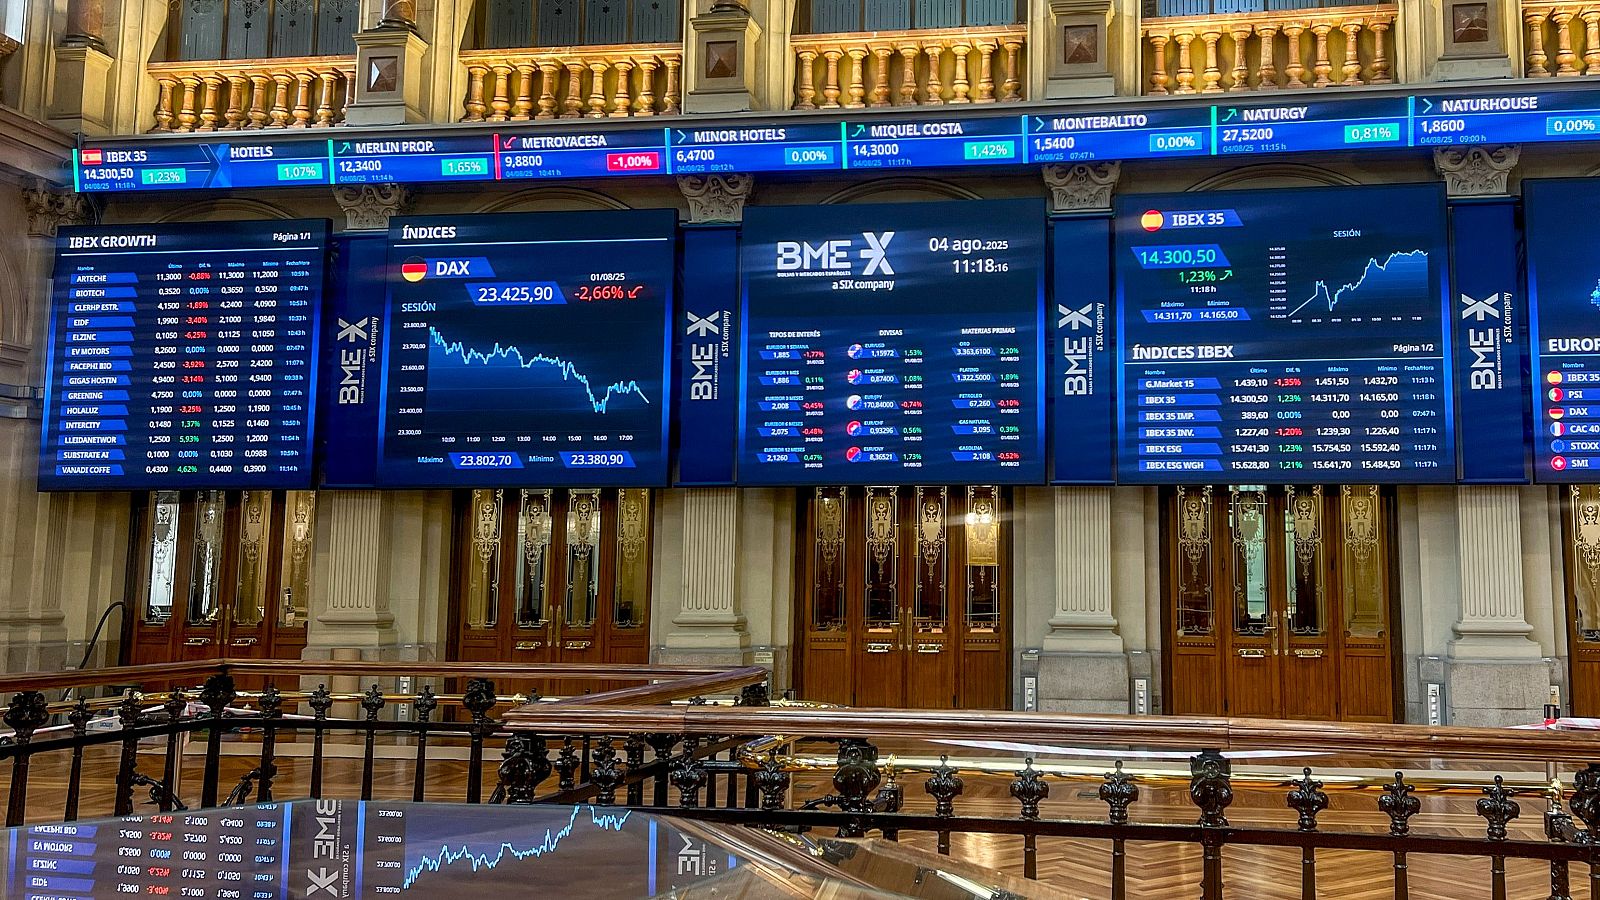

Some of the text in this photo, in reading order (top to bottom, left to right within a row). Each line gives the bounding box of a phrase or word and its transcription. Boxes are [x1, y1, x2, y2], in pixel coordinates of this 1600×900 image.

[1442, 97, 1537, 112] NATURHOUSE
[1244, 107, 1307, 121] NATURGY
[1053, 115, 1147, 132] MONTEBALITO
[1422, 120, 1595, 133] 1,8600 0,00%
[695, 129, 785, 142] MINOR HOTELS
[872, 123, 963, 138] MIQUEL COSTA
[1223, 128, 1391, 142] 27,5200 0,81%
[356, 141, 434, 153] MERLIN PROP.
[522, 135, 607, 148] METROVACESA
[1035, 136, 1195, 151] 1,5400 0,00%
[107, 151, 147, 162] IBEX 35
[231, 146, 273, 158] HOTELS
[677, 150, 827, 162] 6,4700 0,00%
[854, 144, 1007, 157] 14,3000 1,42%
[340, 160, 481, 172] 12,3400 1,65%
[505, 156, 652, 168] 9,8800 -1,00%
[84, 167, 316, 183] 14.300,50 1,23% 1,07%
[1173, 213, 1224, 226] IBEX 35
[273, 233, 298, 242] Página
[402, 225, 456, 239] ÍNDICES
[1334, 229, 1360, 237] SESIÓN
[70, 235, 156, 248] IBEX GROWTH
[930, 238, 1008, 254] 04 ago.2025
[777, 240, 851, 269] BME
[1141, 250, 1215, 264] 14.300,50
[436, 261, 469, 275] DAX
[953, 259, 1008, 273] 11:18:16
[157, 273, 181, 281] 11,3000
[591, 273, 625, 281] 01/08/25
[1180, 271, 1216, 283] 1,23%
[840, 280, 853, 289] SIX
[855, 281, 894, 291] company
[479, 286, 623, 302] 23.425,90 -2,66%
[402, 301, 435, 312] SESIÓN
[1504, 293, 1513, 324] company
[1154, 311, 1238, 320] 14.311,70 14.165,00
[723, 311, 731, 340] company
[1133, 344, 1233, 359] ÍNDICES IBEX
[1394, 344, 1419, 353] Página
[1469, 329, 1495, 389] BME
[691, 344, 713, 399] BME
[1065, 337, 1086, 395] BME
[339, 349, 361, 403] BME
[1146, 380, 1183, 388] G.Market
[1234, 379, 1267, 387] 1.439,10
[1315, 378, 1349, 386] 1.451,50
[1230, 395, 1268, 403] 14.300,50
[1317, 428, 1350, 436] 1.239,30
[1231, 445, 1269, 453] 15.741,30
[461, 456, 511, 466] 23.802,70
[571, 455, 623, 465] 23.380,90
[1362, 461, 1400, 469] 15.484,50
